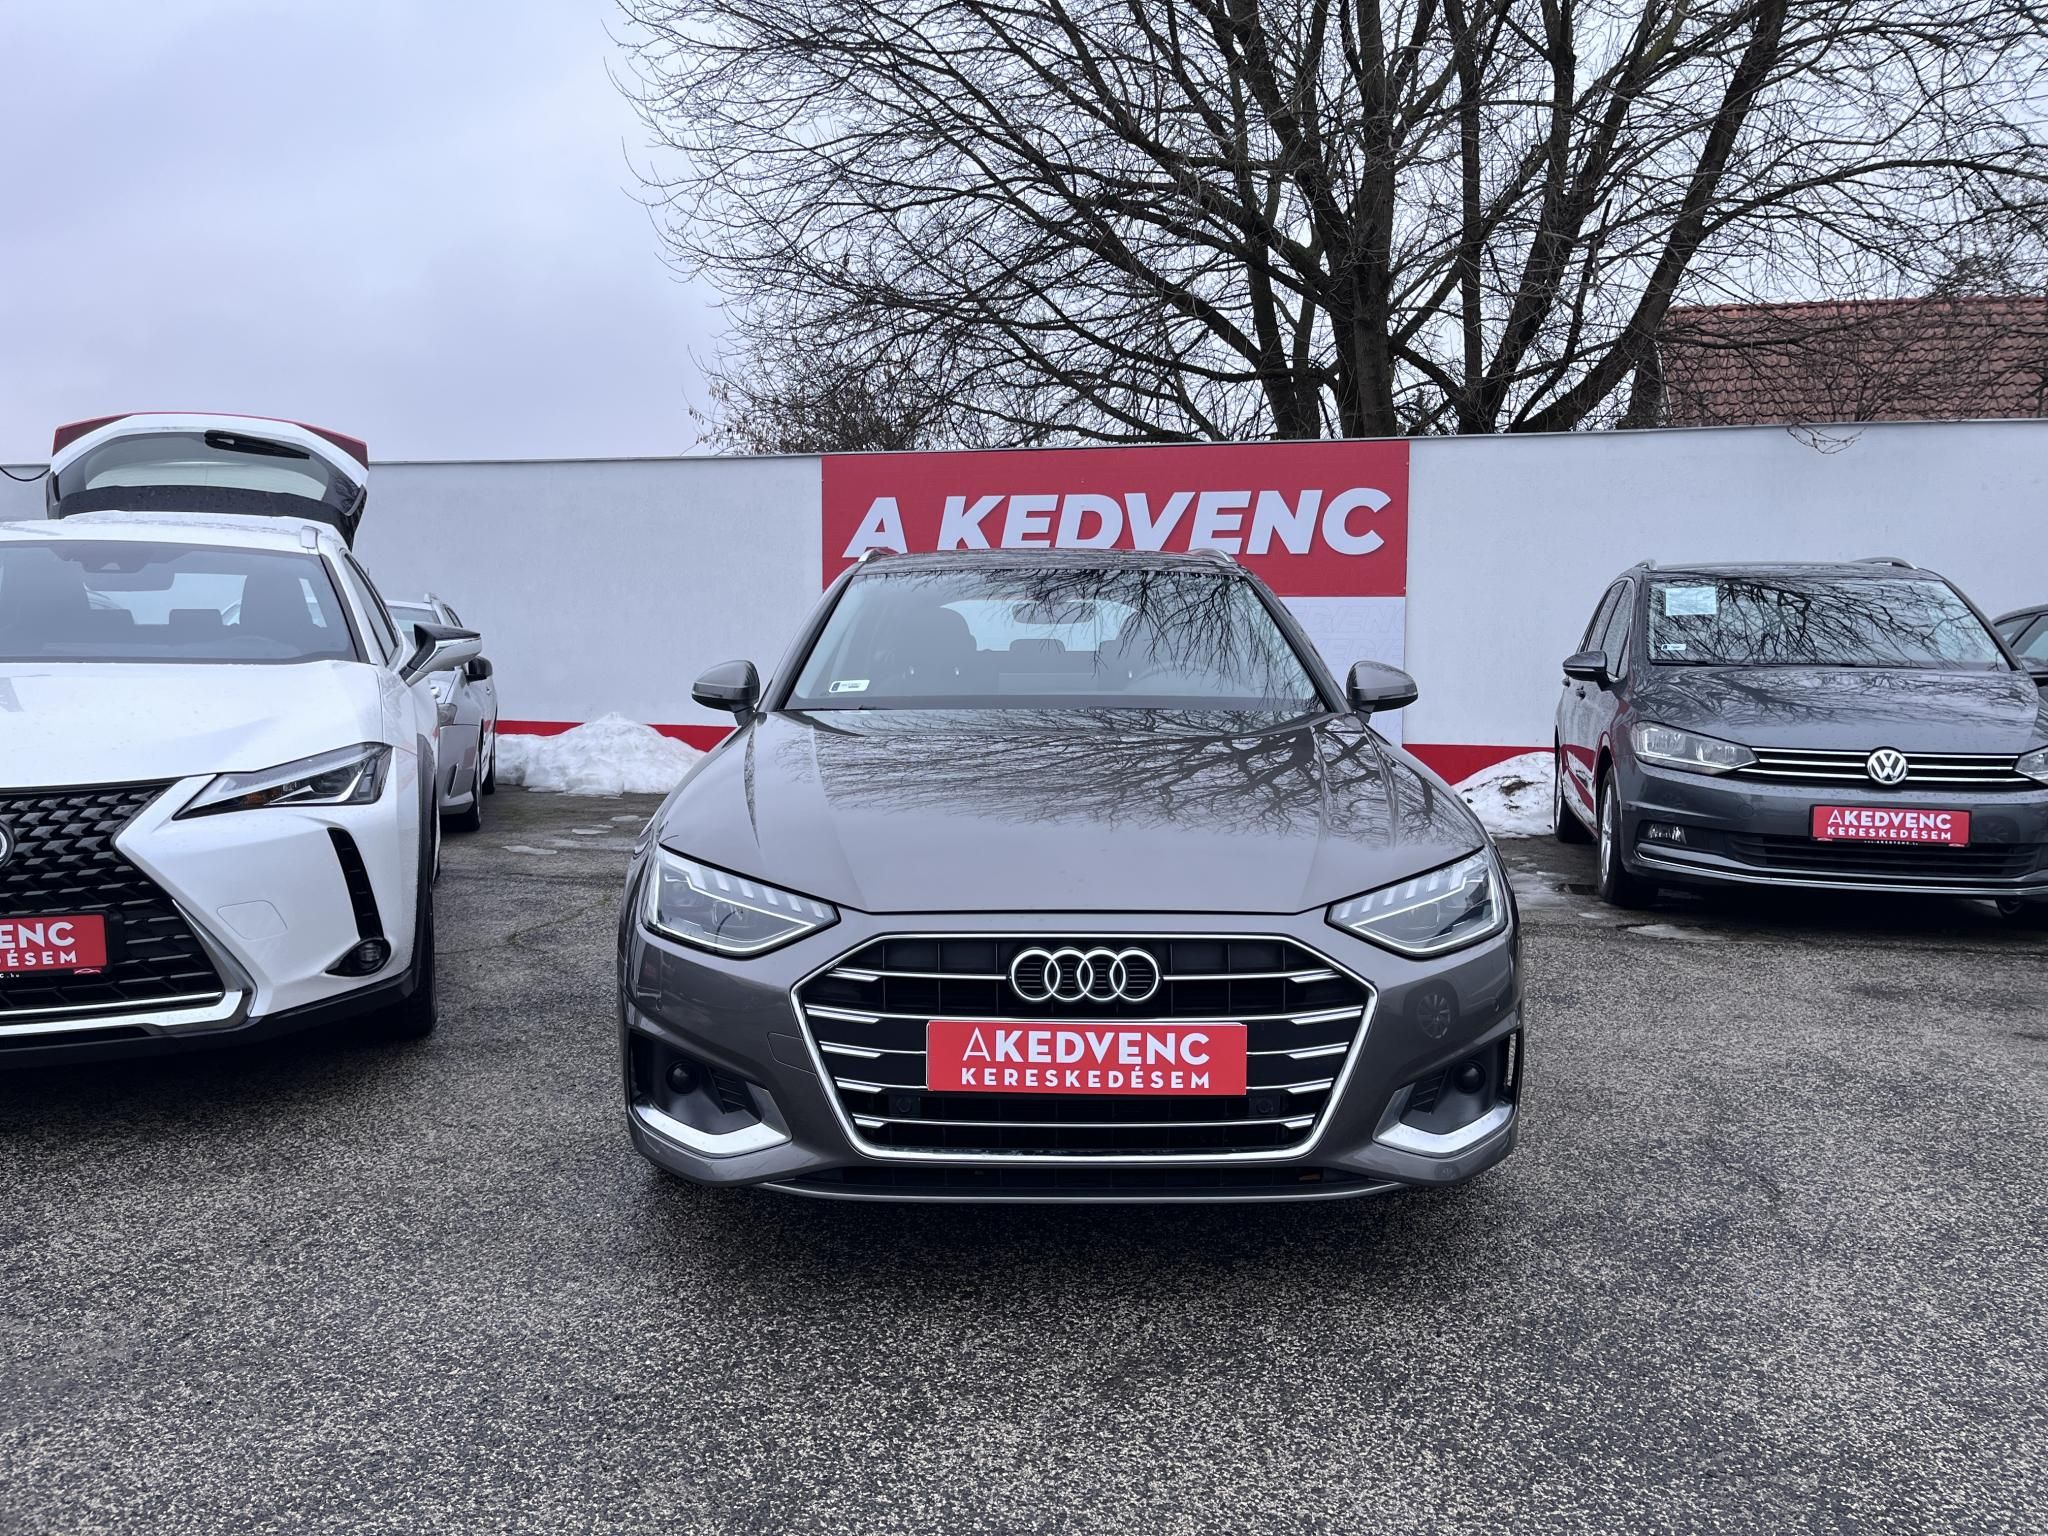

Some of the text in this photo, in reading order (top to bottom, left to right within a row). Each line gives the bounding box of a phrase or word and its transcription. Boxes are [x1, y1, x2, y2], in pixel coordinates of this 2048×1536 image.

[842, 487, 1392, 558] A KEDVENC
[1828, 809, 1952, 829] AKEDVENC
[1827, 826, 1951, 840] KERESKEDÉSEM
[0, 949, 77, 967] ÉSEM
[962, 1027, 1210, 1065] AKEDVENC
[961, 1066, 1210, 1089] KERESKEDÉSEM
